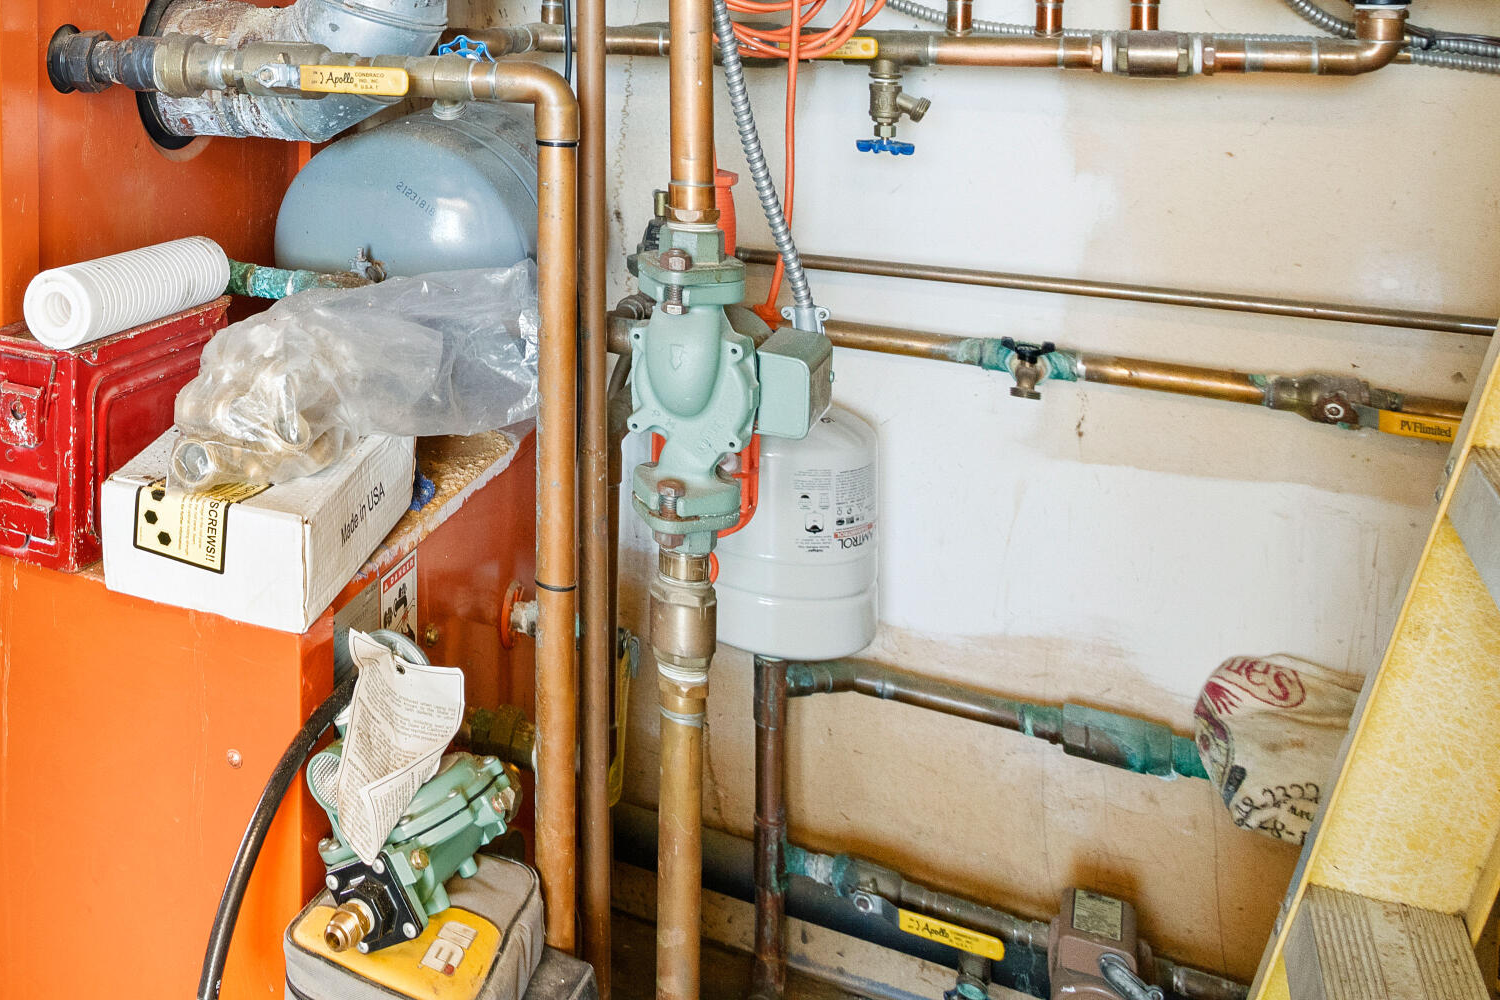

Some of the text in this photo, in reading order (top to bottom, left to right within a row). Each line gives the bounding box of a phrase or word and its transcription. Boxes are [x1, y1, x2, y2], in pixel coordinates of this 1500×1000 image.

[325, 72, 355, 88] Apollo
[1400, 419, 1453, 438] PVFlimited
[340, 481, 386, 548] Made in USA
[204, 501, 220, 563] SCREWS!!
[390, 555, 415, 585] DANGER
[921, 922, 950, 939] Apollo
